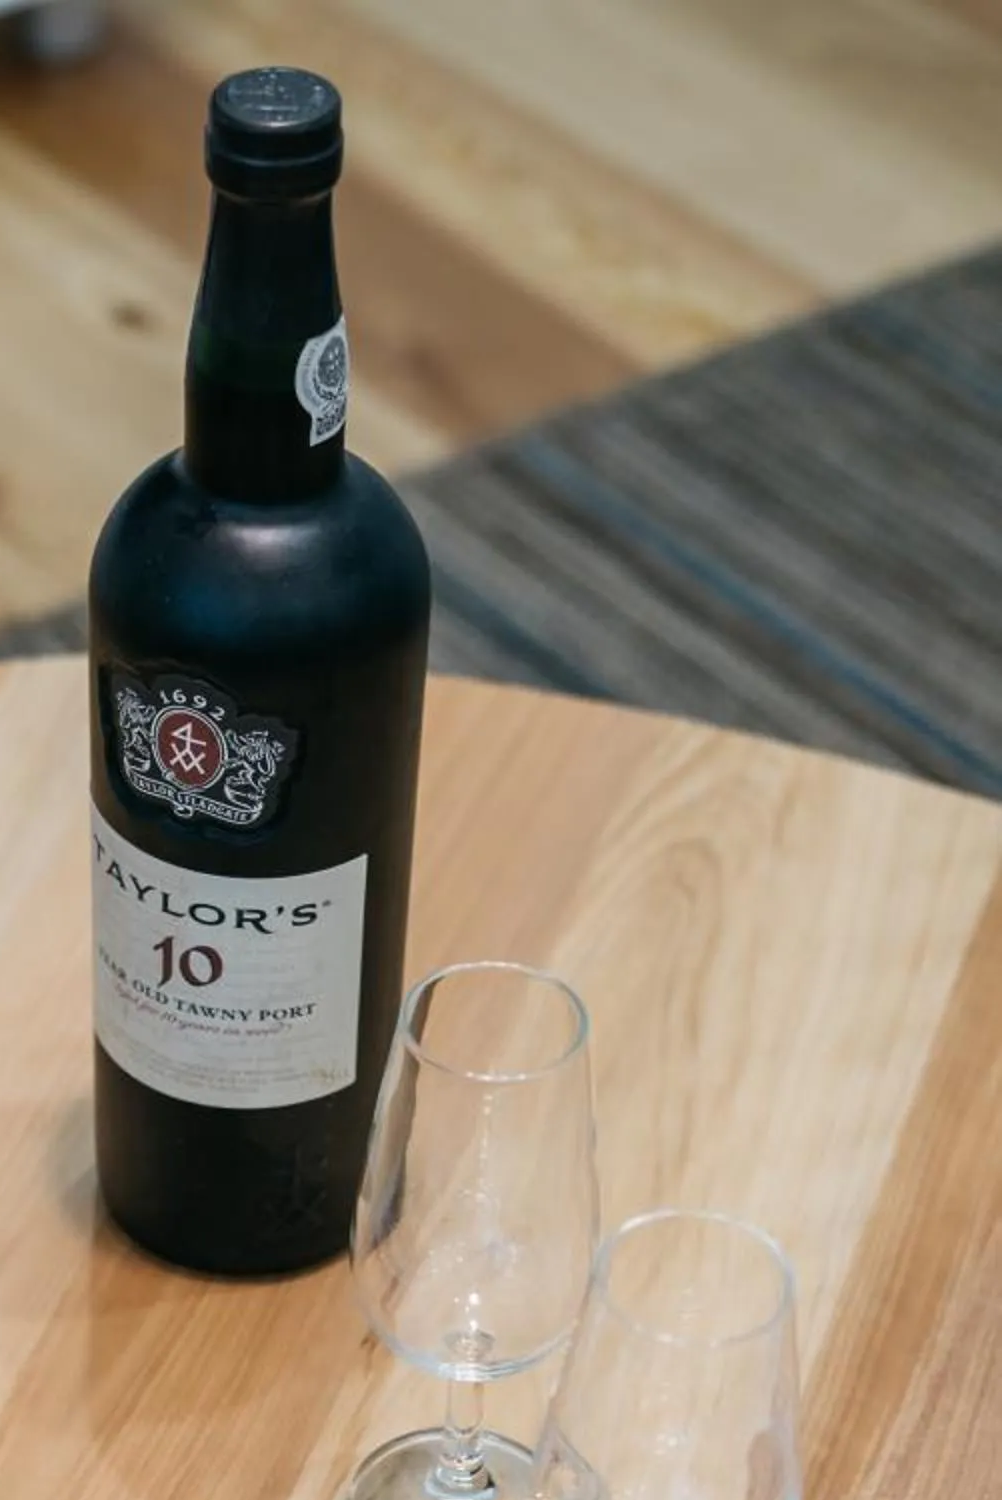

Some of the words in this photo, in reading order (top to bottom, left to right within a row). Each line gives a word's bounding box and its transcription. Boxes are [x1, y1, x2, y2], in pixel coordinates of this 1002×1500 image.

[159, 689, 226, 721] 1692
[94, 833, 319, 933] TAYLOR'S
[153, 935, 223, 987] 10
[132, 979, 169, 1005] OLD
[172, 998, 253, 1022] TAWNY
[259, 1002, 317, 1022] PORT
